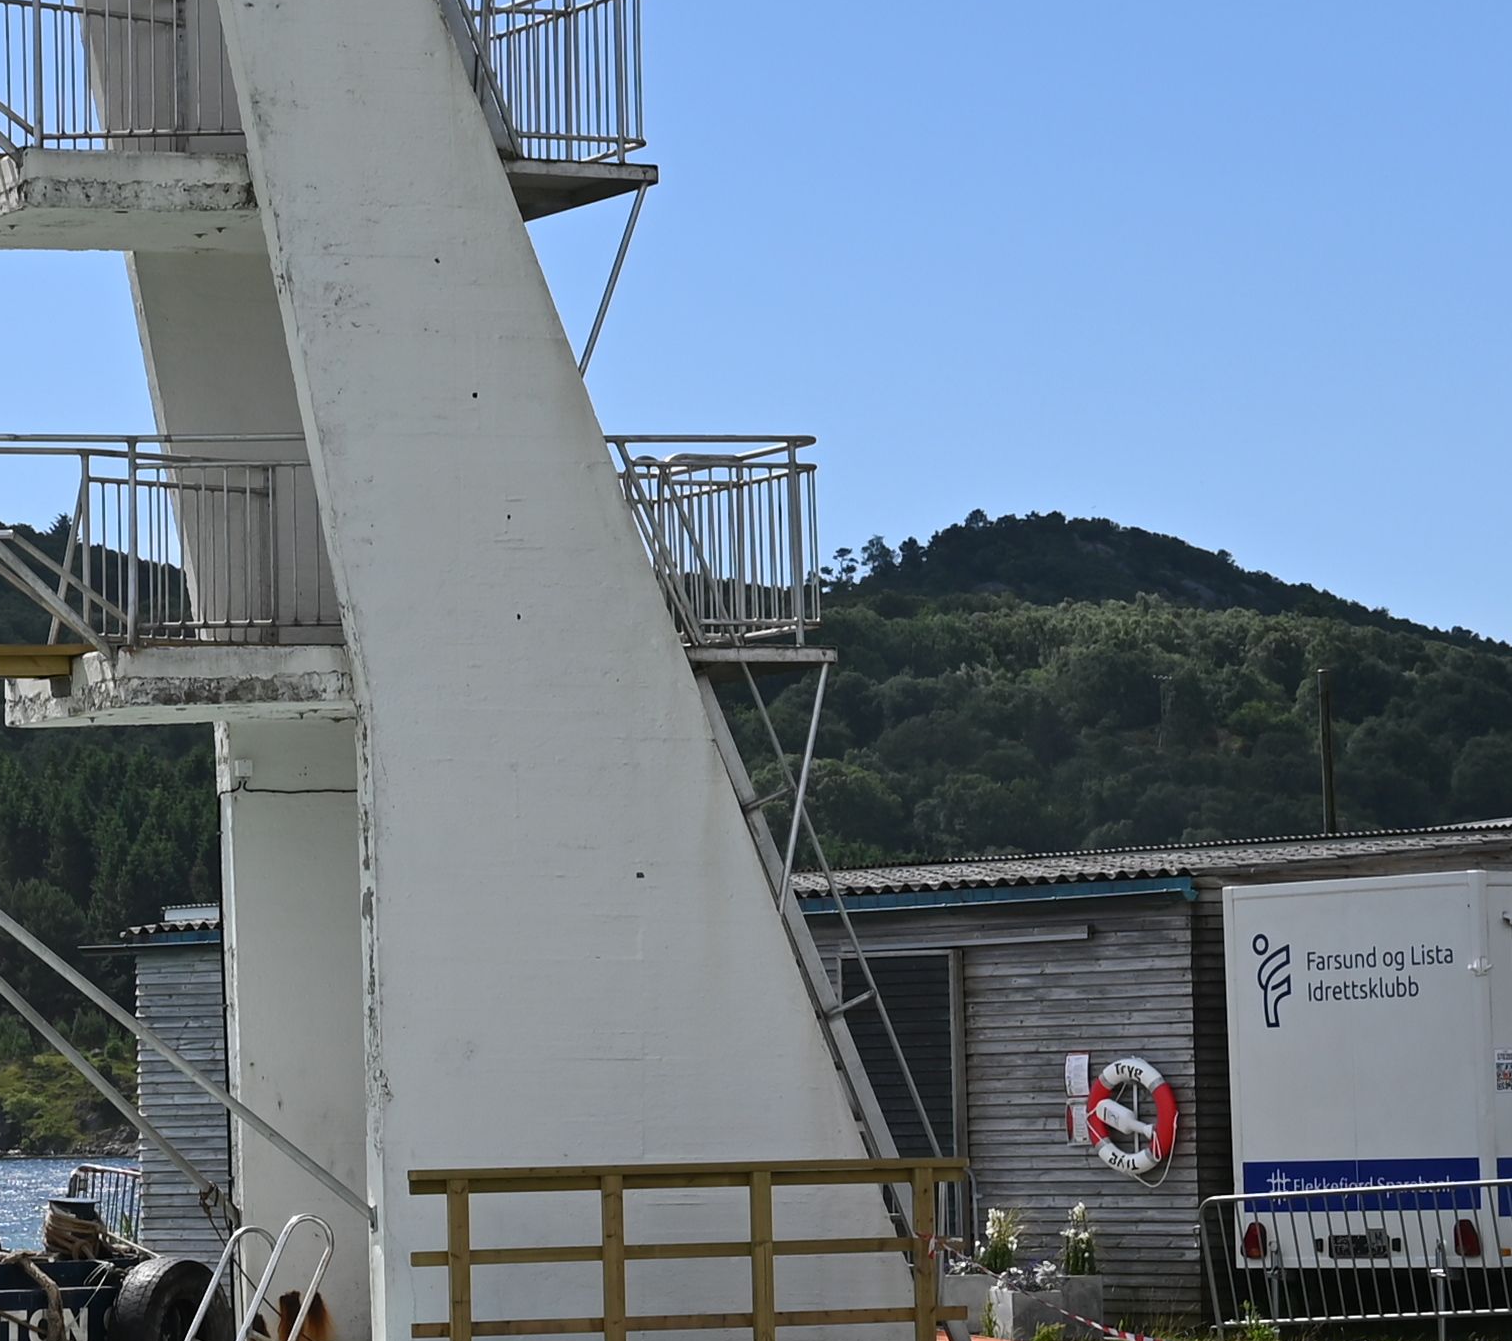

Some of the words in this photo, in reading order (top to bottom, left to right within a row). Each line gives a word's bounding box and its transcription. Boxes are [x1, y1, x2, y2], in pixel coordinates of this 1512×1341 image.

[1306, 946, 1377, 971] Farsund
[1382, 950, 1405, 971] og
[1410, 944, 1454, 966] Lista
[1307, 975, 1420, 1002] Idrettsklubb
[1114, 1063, 1143, 1082] Tryg
[1294, 1176, 1373, 1199] Flekkefjord
